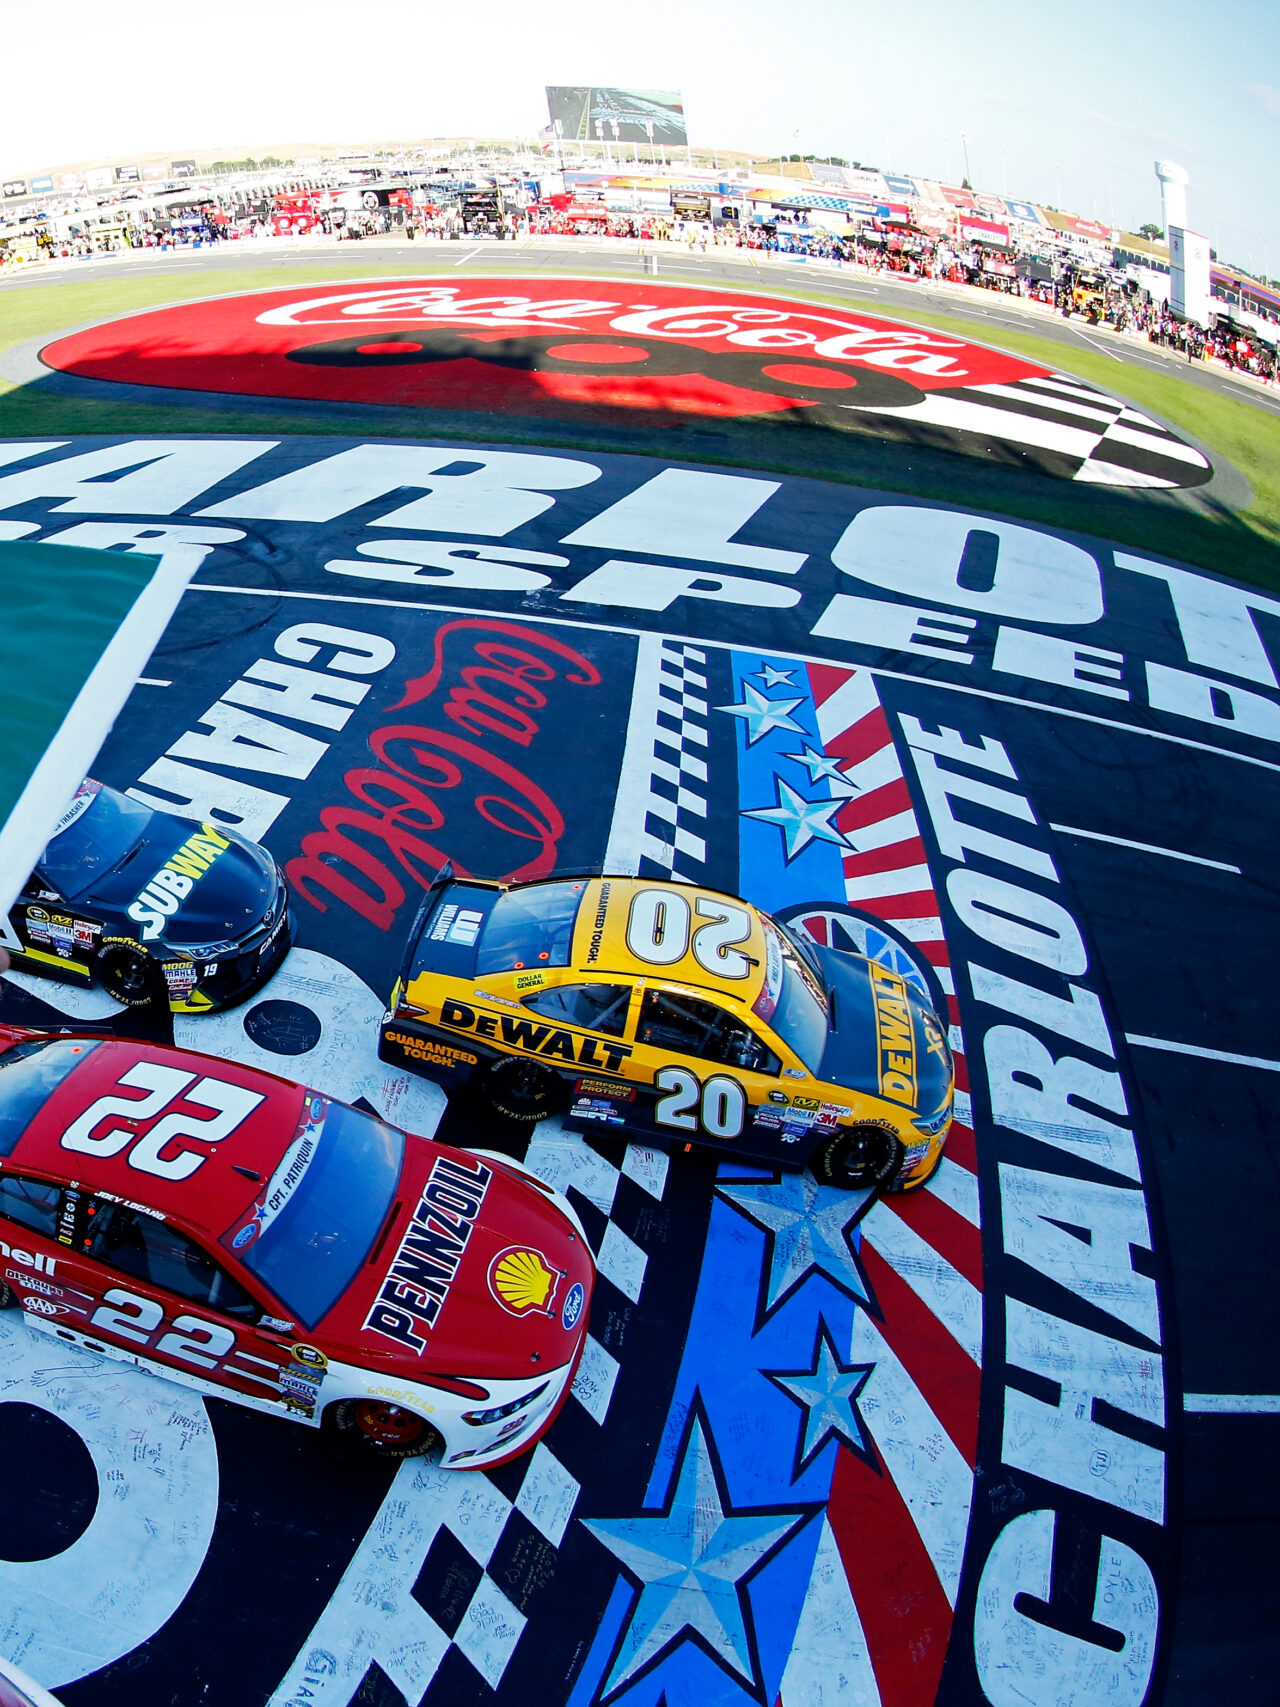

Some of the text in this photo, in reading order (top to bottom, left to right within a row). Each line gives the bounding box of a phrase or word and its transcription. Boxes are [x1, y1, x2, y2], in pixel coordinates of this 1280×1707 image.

[256, 287, 968, 378] Coca-Cola
[325, 539, 1280, 743] SPEED
[127, 822, 234, 941] SUBWAY
[596, 882, 612, 928] GUARANTEED
[74, 929, 92, 943] 3M
[259, 910, 287, 955] CAMRY
[431, 904, 459, 941] WILLIAMS
[625, 888, 752, 980] 20
[102, 936, 149, 954] GOODYEAR
[161, 961, 194, 970] MOOG
[165, 969, 196, 977] MAHLE
[203, 963, 218, 977] 19
[517, 973, 542, 983] DOLLAR
[516, 979, 545, 989] GENERAL
[384, 1031, 478, 1066] GUARANTEED
[580, 1085, 630, 1098] PROTECT
[582, 1079, 632, 1093] PERFORM
[653, 1063, 747, 1140] 20
[60, 1061, 268, 1181] 22
[788, 1107, 806, 1117] Mobil
[816, 1112, 838, 1126] 3M
[268, 1138, 314, 1211] CPT. PATRIQUIN
[94, 1190, 167, 1222] JOEY LOGANO
[896, 711, 1168, 1707] CHARLOTTE
[360, 1154, 494, 1356] PENNZOIL
[5, 1268, 64, 1297] DISCOUNT
[23, 1297, 56, 1315] AAA
[563, 1286, 583, 1327] Ford
[89, 1288, 237, 1370] 22
[367, 1385, 436, 1414] GOODYEAR
